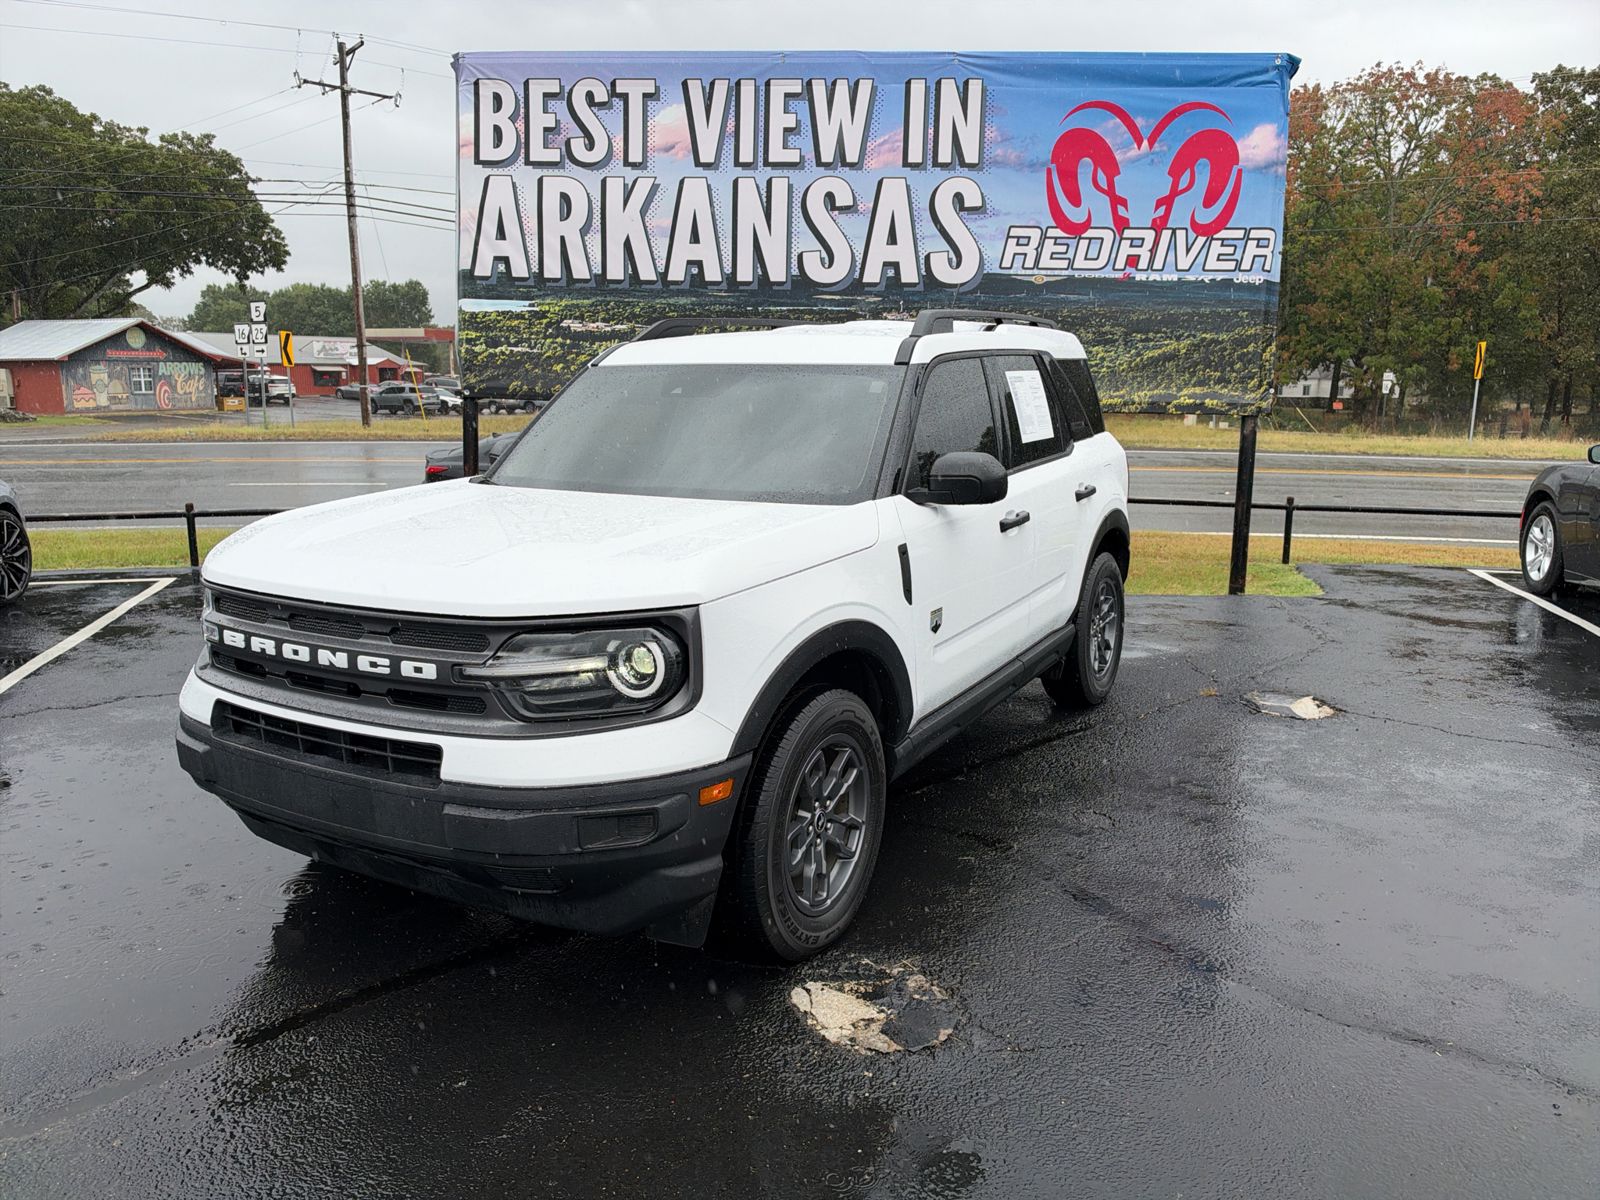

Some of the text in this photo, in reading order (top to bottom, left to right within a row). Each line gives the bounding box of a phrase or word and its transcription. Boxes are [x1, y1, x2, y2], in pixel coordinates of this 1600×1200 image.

[474, 77, 985, 169] BEST VIEW IN
[470, 174, 985, 286] ARKANSAS
[1135, 273, 1178, 281] RAM
[1233, 273, 1264, 285] Jeep
[254, 305, 261, 318] 5
[237, 328, 246, 340] 16
[254, 328, 264, 340] 25
[159, 361, 205, 376] ARROWS
[222, 629, 438, 681] BRONCO
